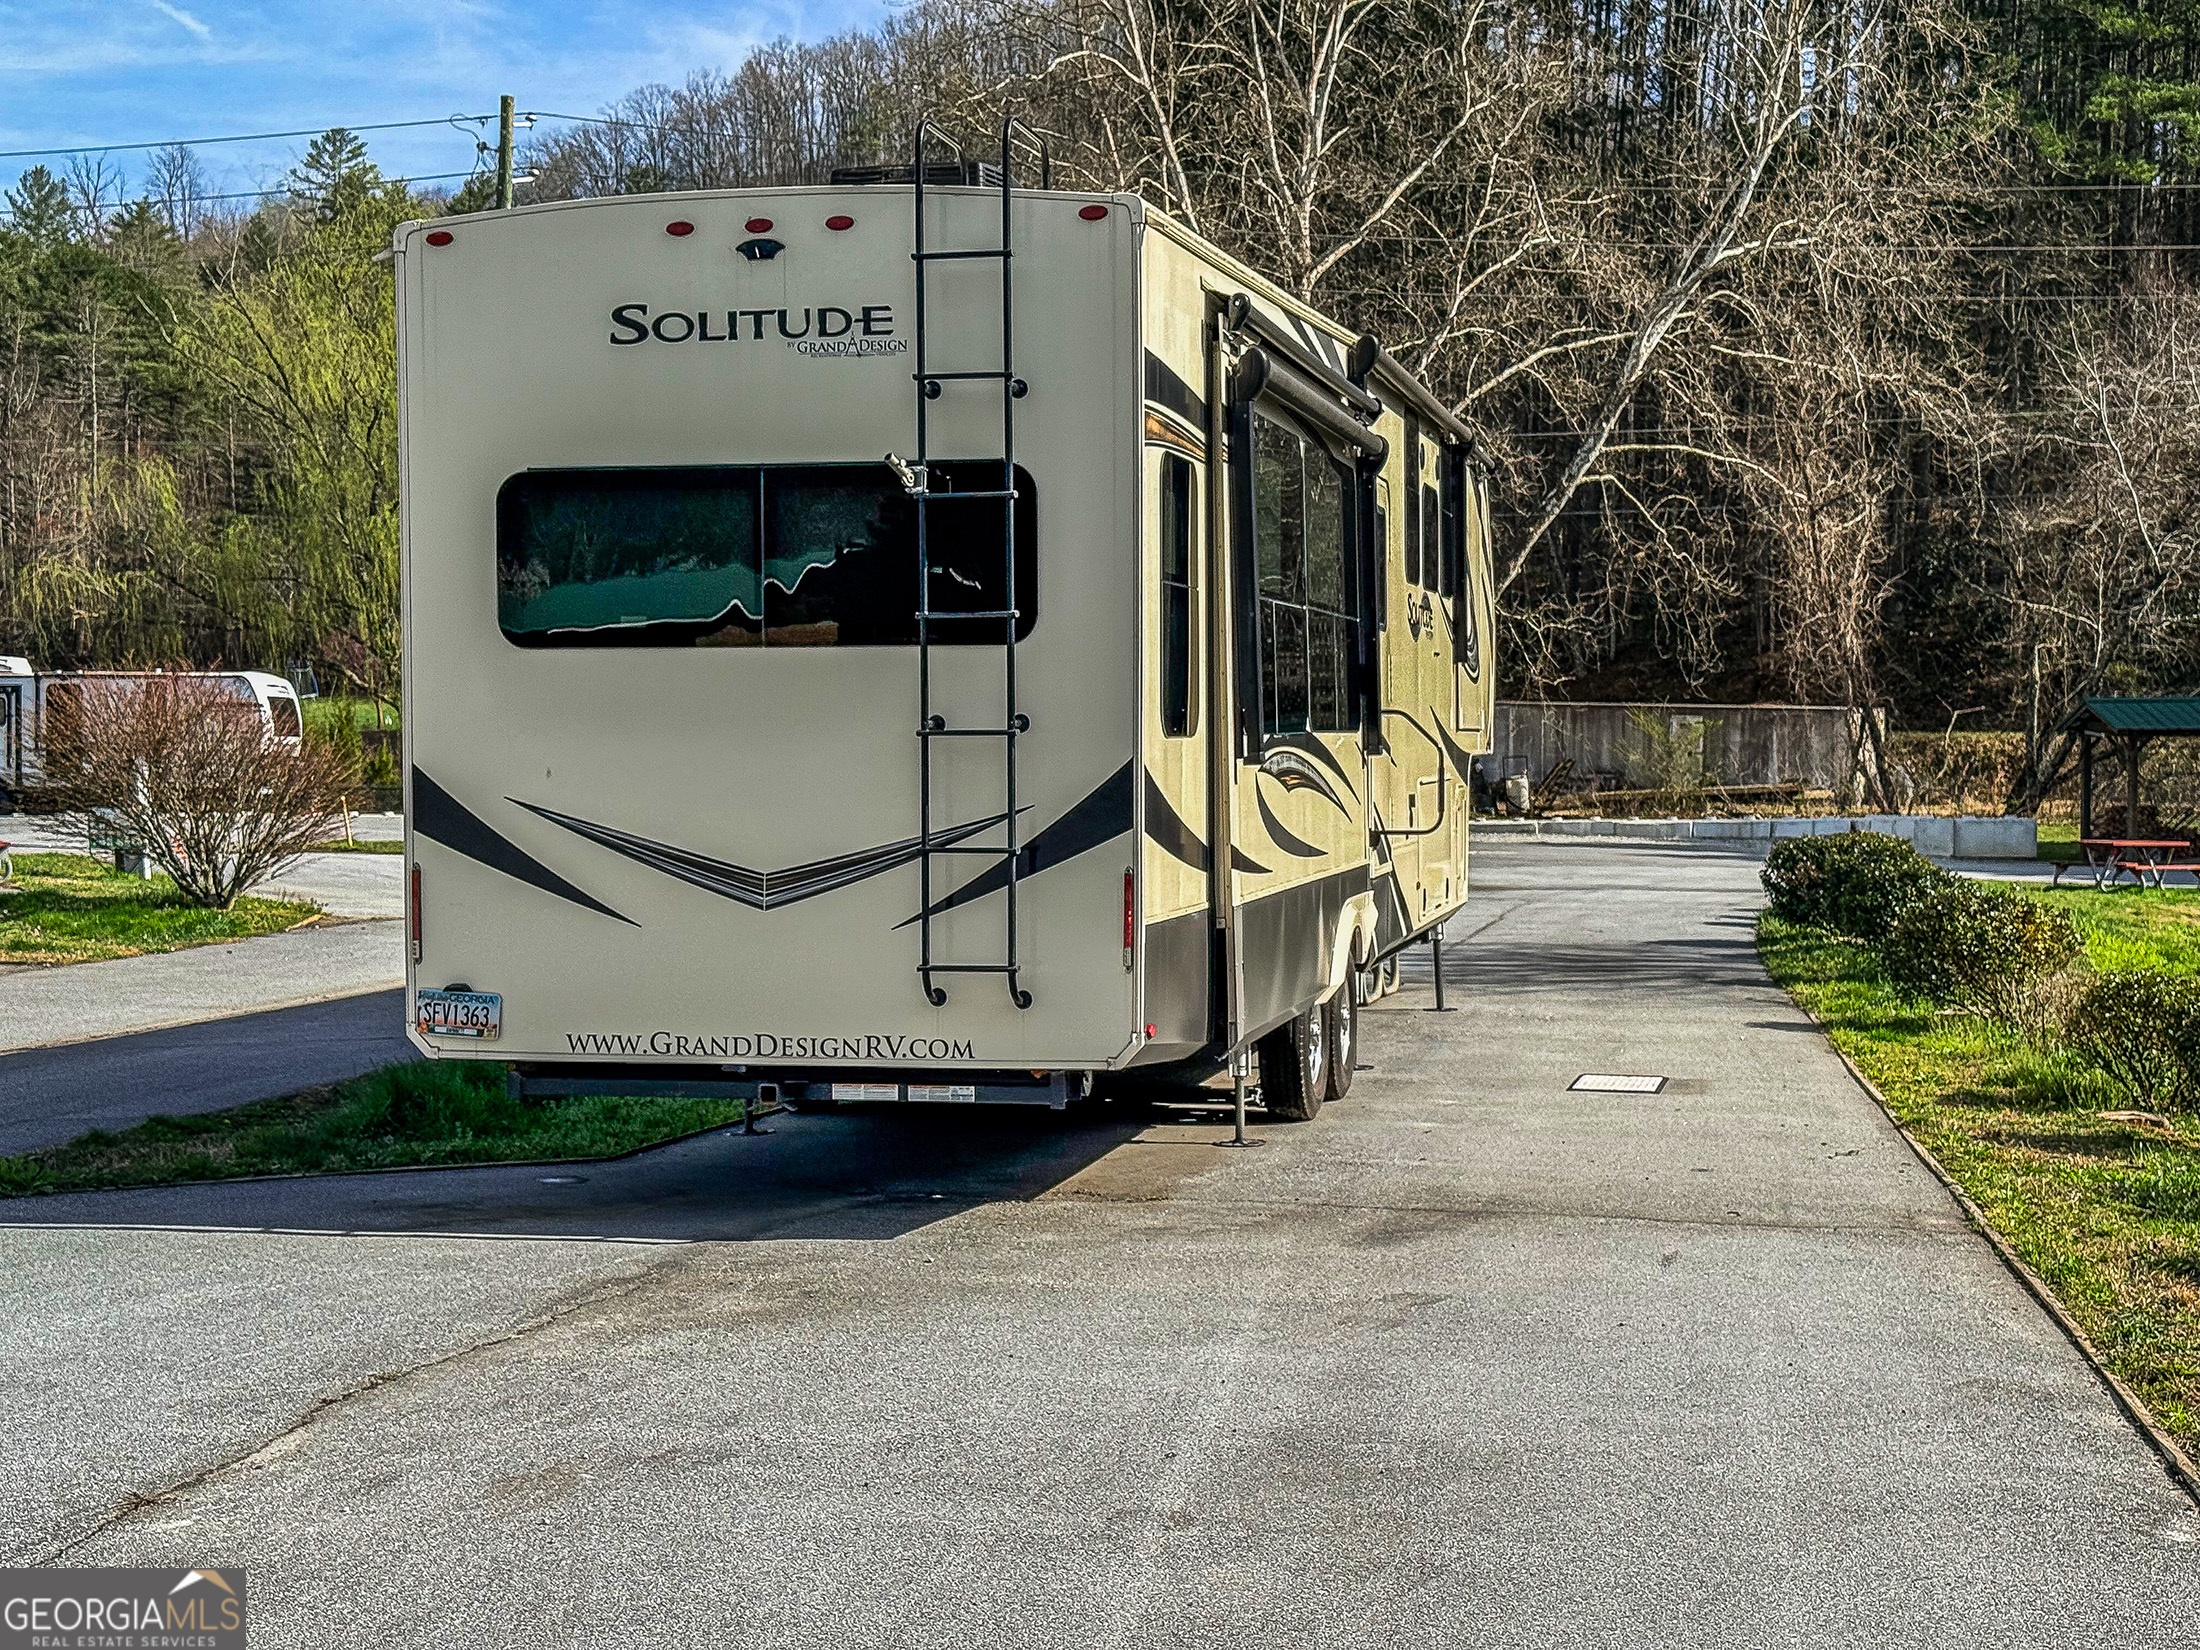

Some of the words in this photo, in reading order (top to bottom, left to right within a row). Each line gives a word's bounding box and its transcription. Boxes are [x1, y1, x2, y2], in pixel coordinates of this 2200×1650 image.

[609, 303, 895, 345] SOLITUDE
[449, 993, 496, 1005] GEORGIA
[423, 1002, 490, 1028] SFV1363
